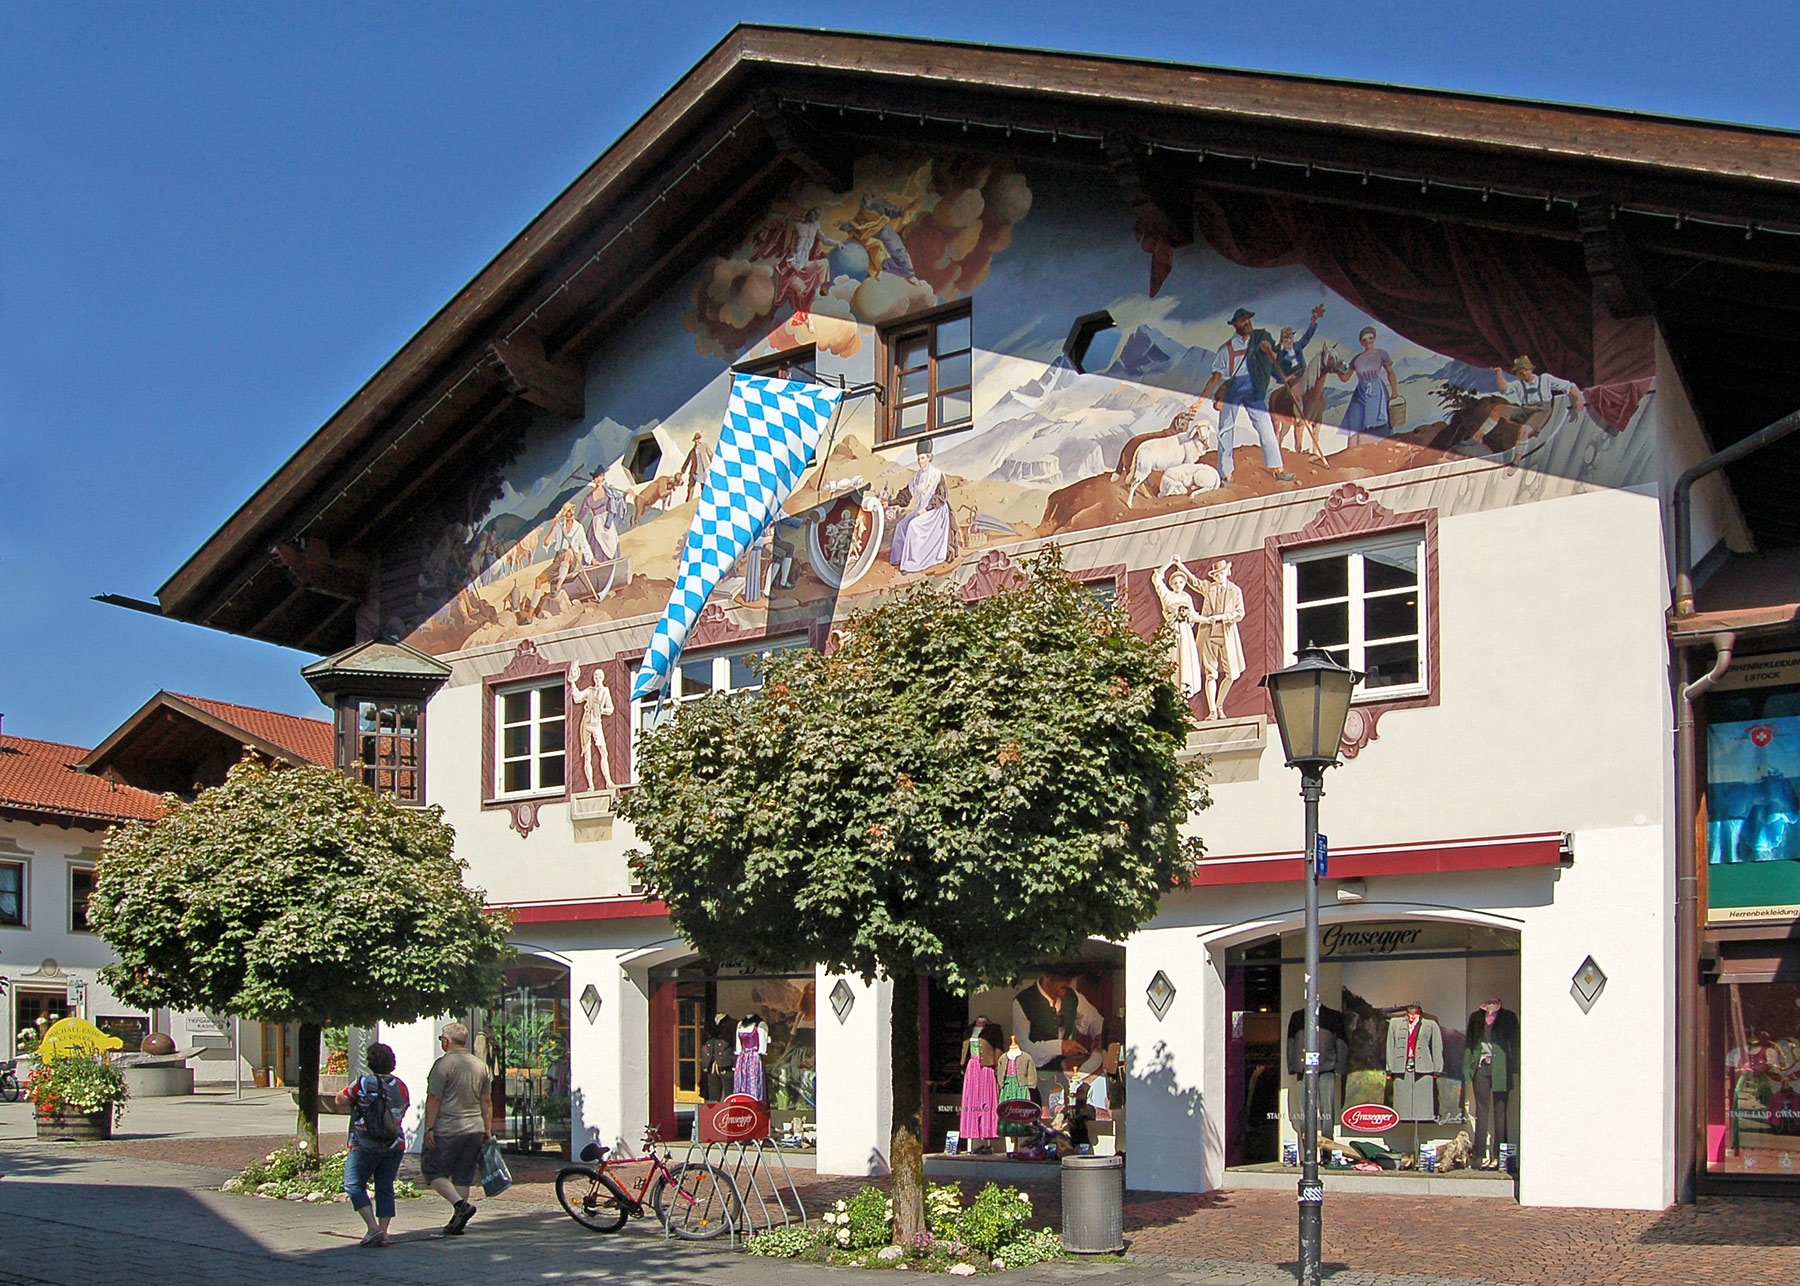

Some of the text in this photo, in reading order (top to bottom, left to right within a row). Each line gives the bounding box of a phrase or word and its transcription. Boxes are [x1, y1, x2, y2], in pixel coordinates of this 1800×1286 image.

[1729, 909, 1798, 918] Herrenbekleidung
[1322, 924, 1422, 956] Grasegger
[718, 1112, 753, 1129] Grasegger
[1348, 1110, 1393, 1125] Grasegger
[1752, 1110, 1773, 1118] LAND
